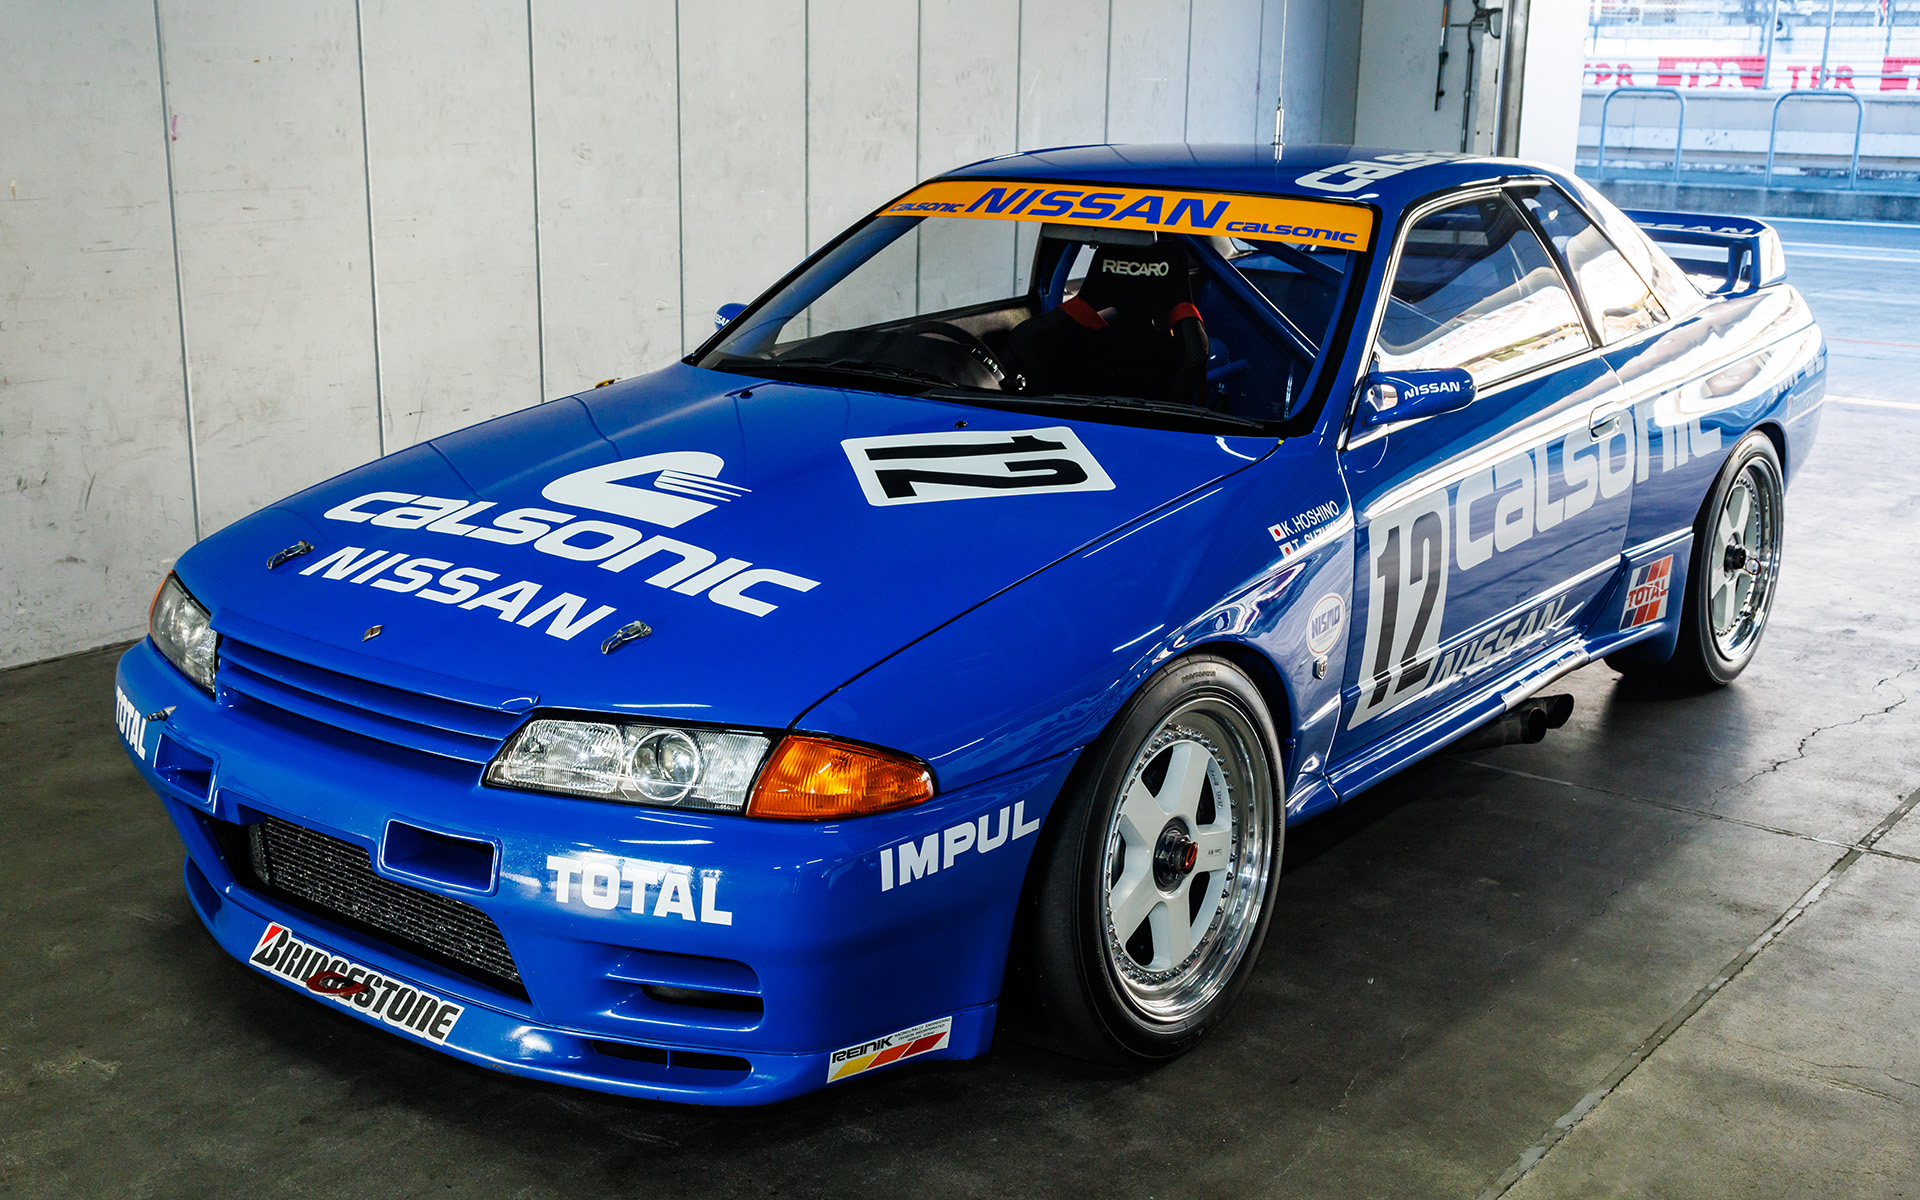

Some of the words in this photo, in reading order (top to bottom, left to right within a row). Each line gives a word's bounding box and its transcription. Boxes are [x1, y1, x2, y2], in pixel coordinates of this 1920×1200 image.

[1675, 61, 1743, 87] TPR
[1786, 65, 1855, 89] TPR
[965, 187, 1230, 229] NISSAN
[1102, 259, 1169, 277] RECARO
[1404, 381, 1460, 400] NISSAN
[864, 435, 1088, 499] 12
[1280, 500, 1340, 537] K.HOSHINO
[299, 546, 617, 641] NISSAN
[1367, 511, 1443, 710] 12
[1628, 578, 1668, 608] TOTAL
[1311, 604, 1341, 640] NISMO
[1433, 595, 1567, 687] NISSAN
[115, 685, 147, 761] TOTAL
[880, 800, 1041, 892] IMPUL
[547, 855, 732, 926] TOTAL
[251, 928, 460, 1041] BRIDGESTONE
[832, 1035, 894, 1064] REINIK
